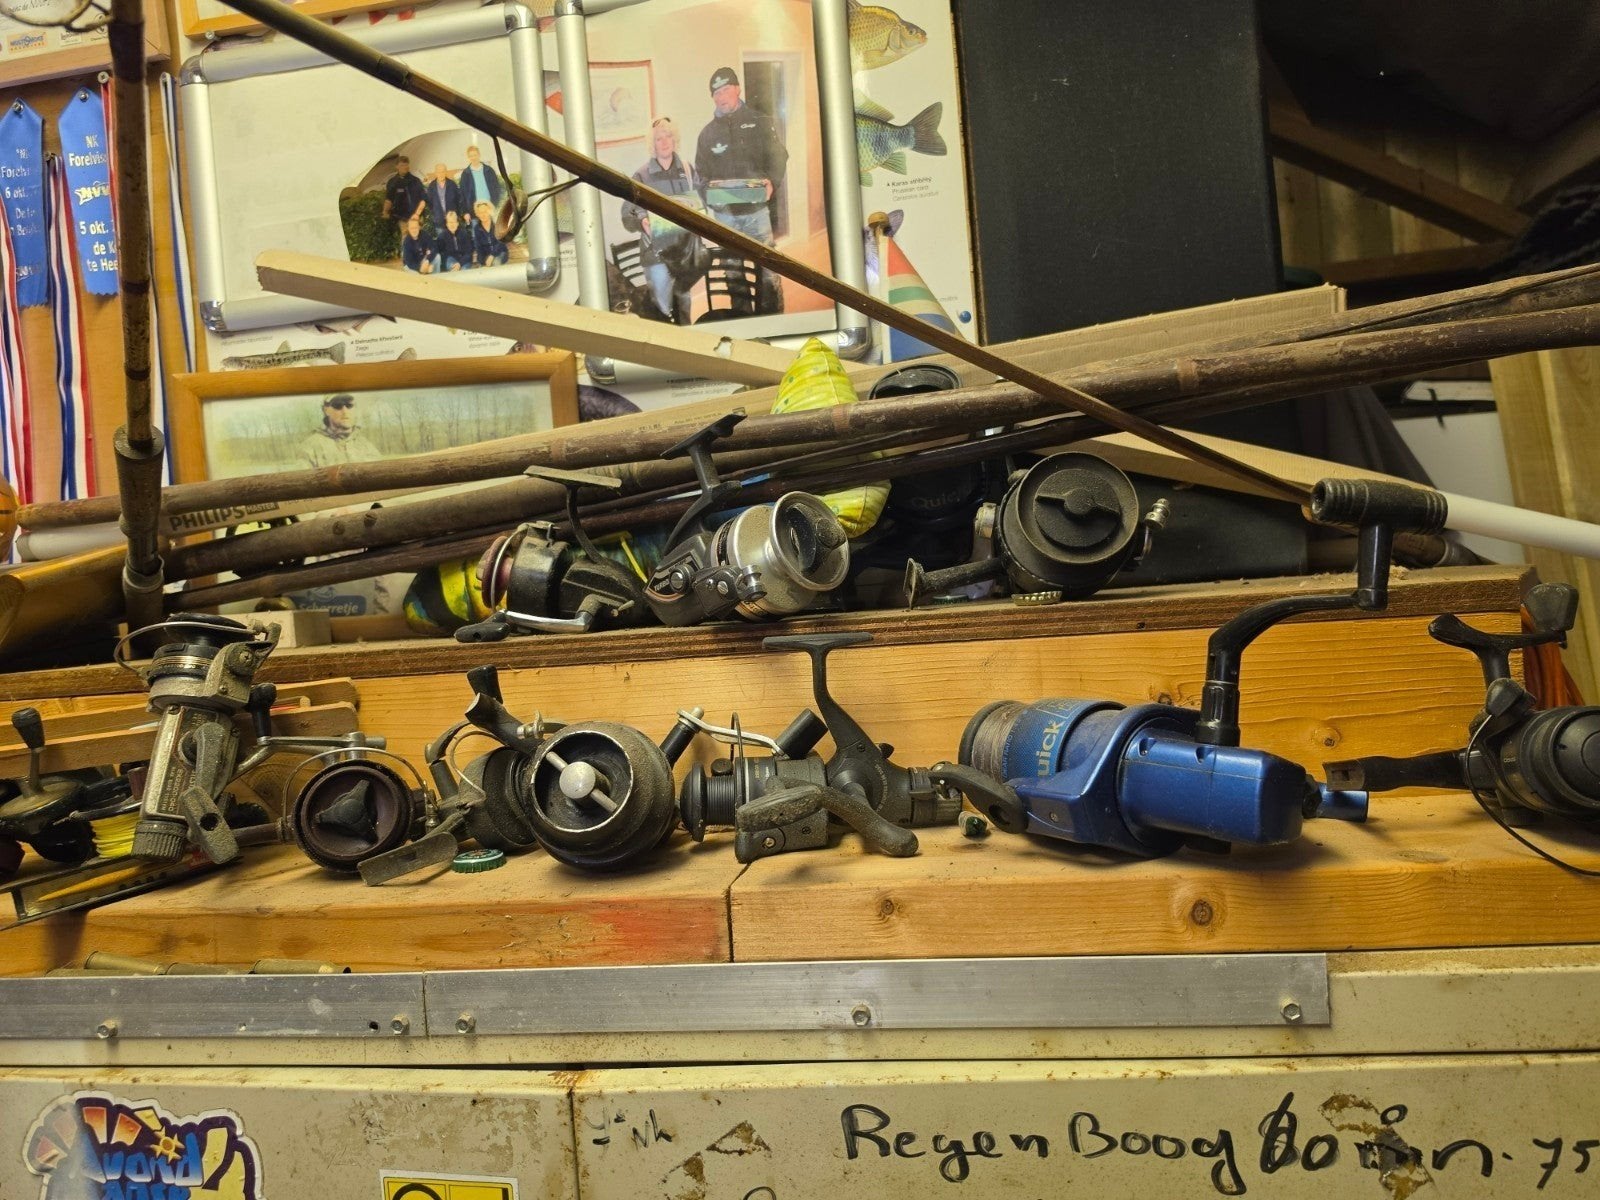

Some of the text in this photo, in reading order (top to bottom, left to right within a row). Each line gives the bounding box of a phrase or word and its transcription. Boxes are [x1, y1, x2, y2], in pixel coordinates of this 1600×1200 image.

[85, 135, 99, 148] NK
[80, 221, 87, 235] 5
[90, 221, 108, 235] okt.
[93, 241, 106, 255] de
[87, 259, 98, 272] te
[169, 501, 278, 532] PHILIPS MASTER
[1036, 719, 1066, 777] uick
[1532, 1136, 1600, 1190] 75
